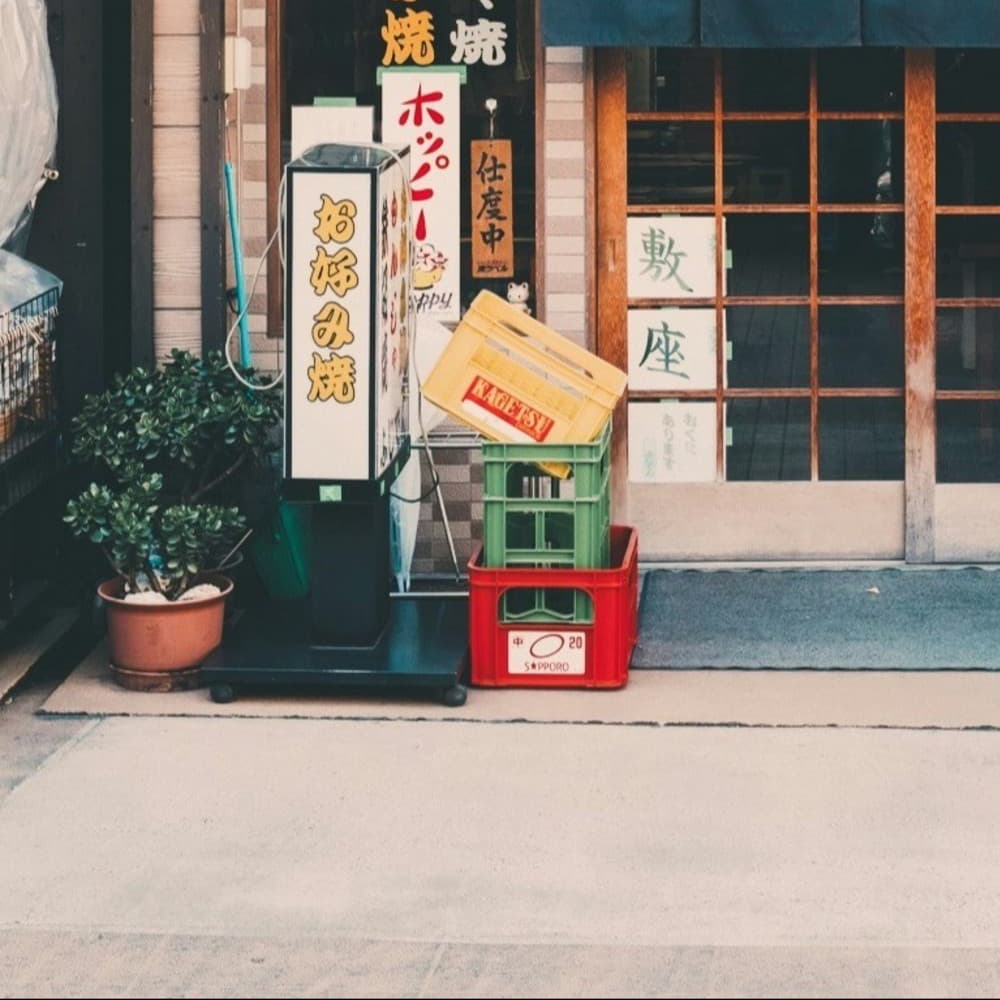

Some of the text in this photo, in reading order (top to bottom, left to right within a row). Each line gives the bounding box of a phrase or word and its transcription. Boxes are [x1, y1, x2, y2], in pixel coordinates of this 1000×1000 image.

[399, 81, 450, 241] ホッピー
[476, 151, 508, 255] 仕度中
[306, 193, 360, 405] お好み焼
[470, 378, 551, 433] KAGETSU
[568, 636, 582, 649] 20
